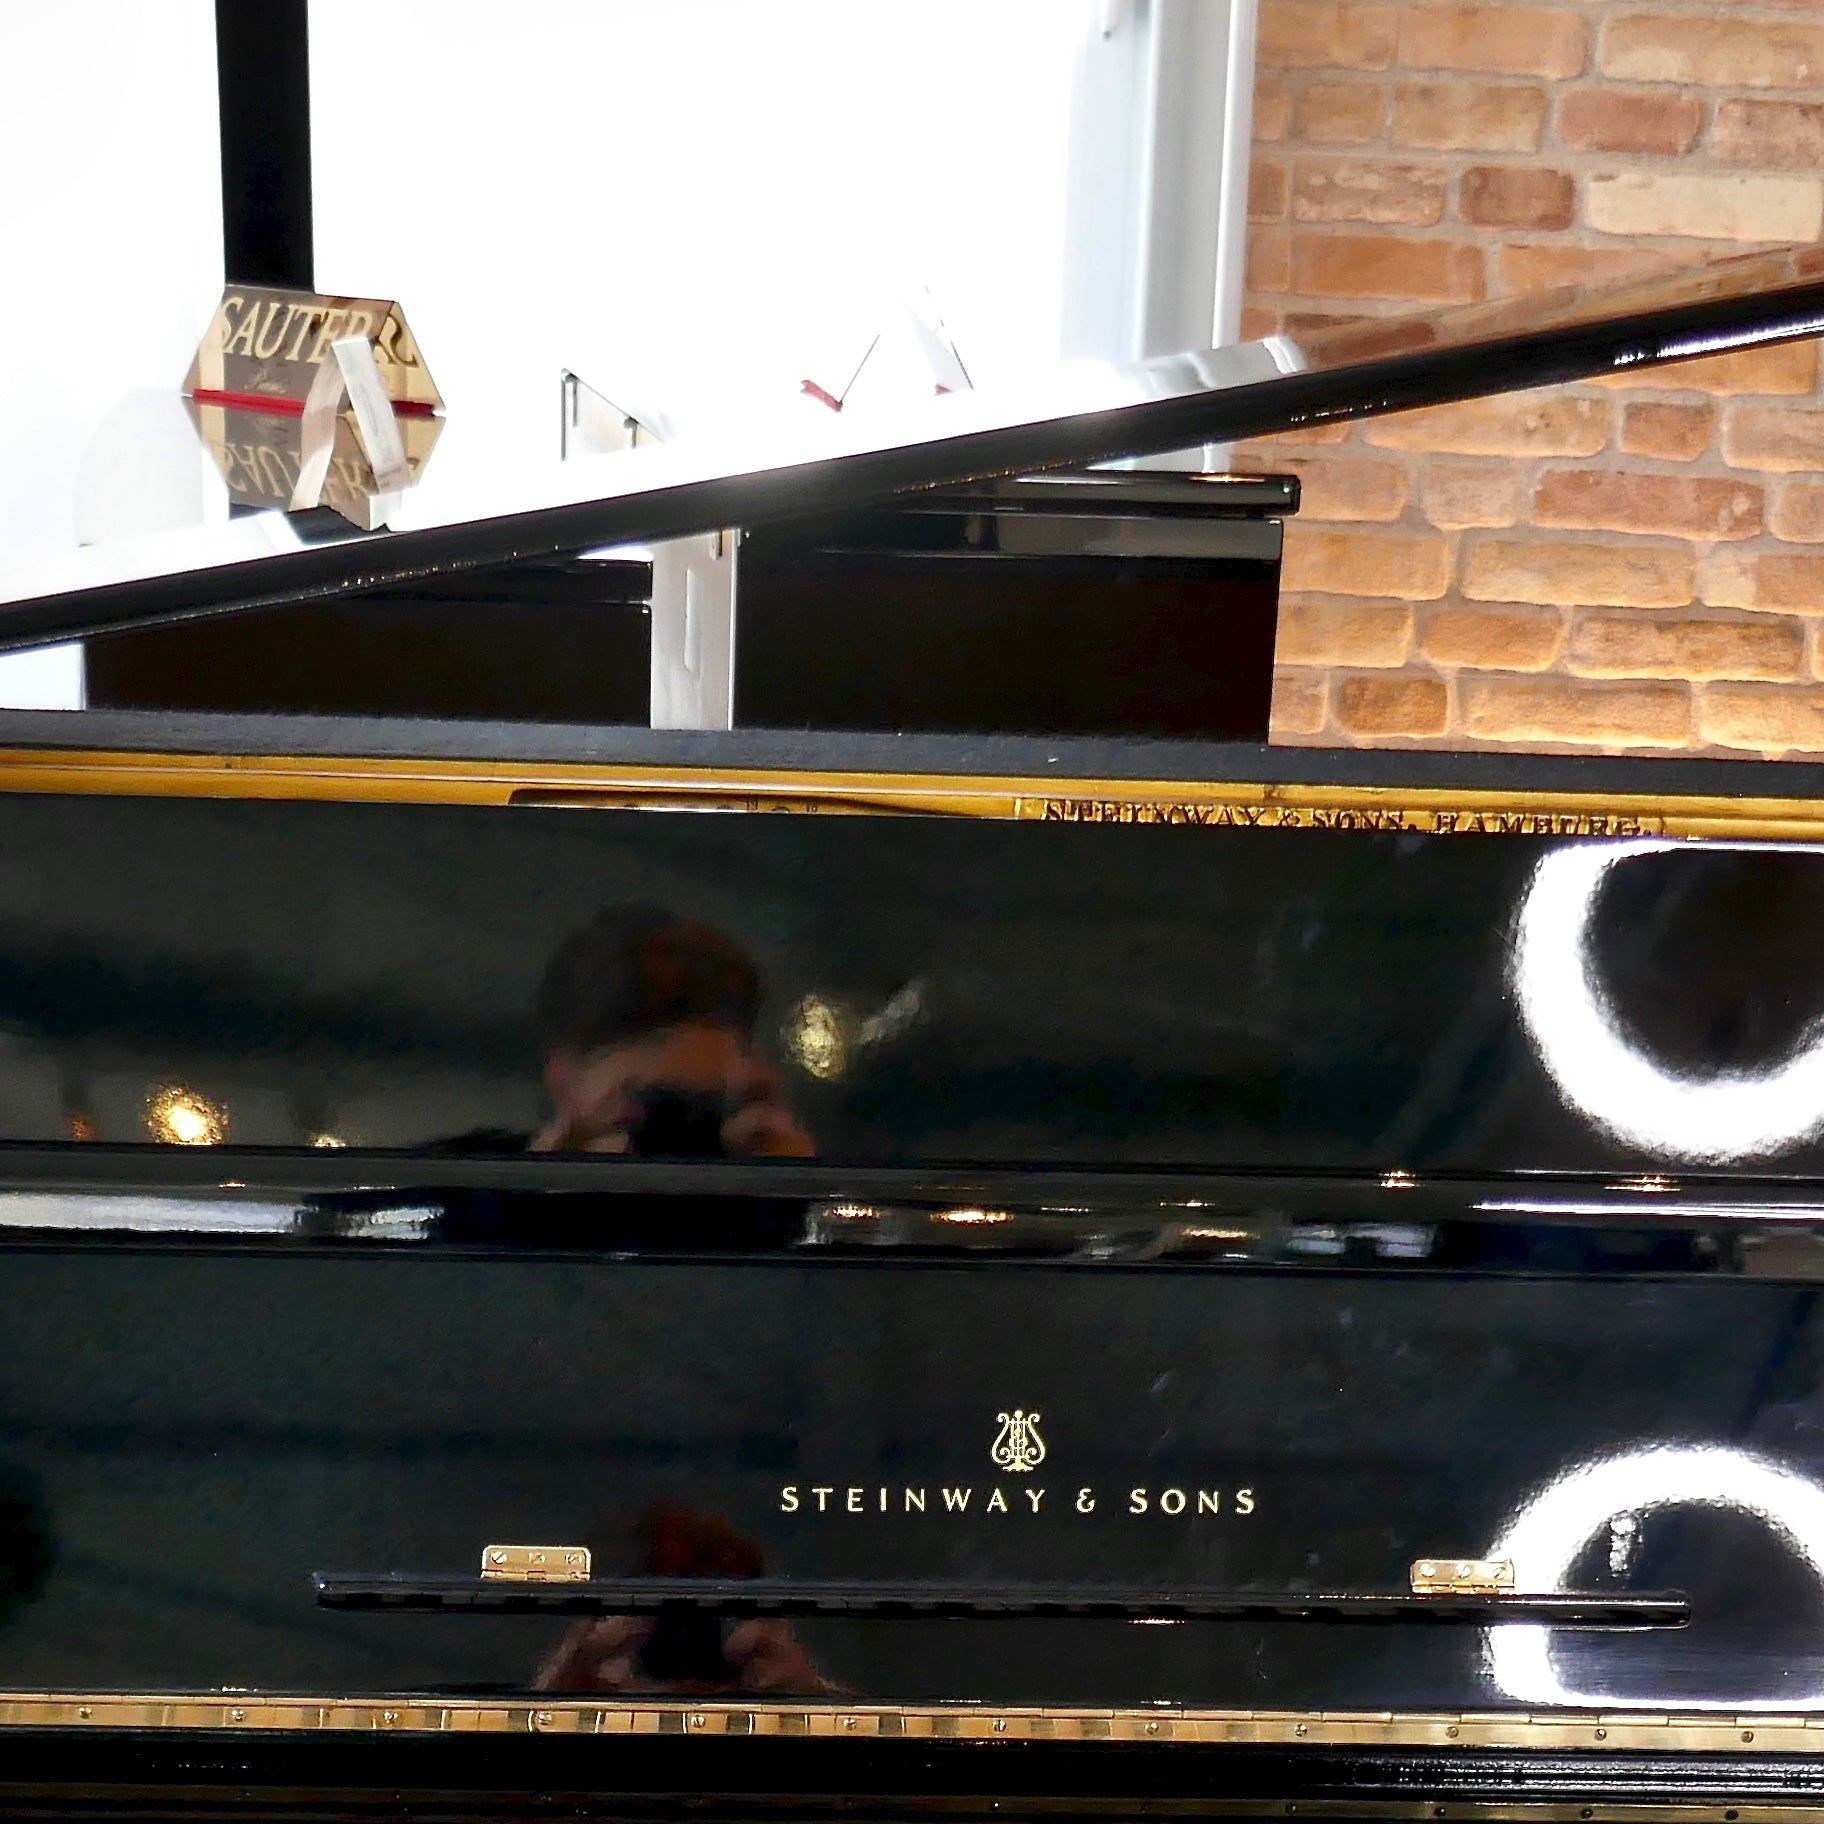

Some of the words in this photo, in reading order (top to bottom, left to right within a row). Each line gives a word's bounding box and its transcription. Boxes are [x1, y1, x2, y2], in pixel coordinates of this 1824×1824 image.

[780, 1486, 1046, 1514] STEINWAY
[1076, 1487, 1096, 1514] &
[1129, 1488, 1256, 1515] SONS
